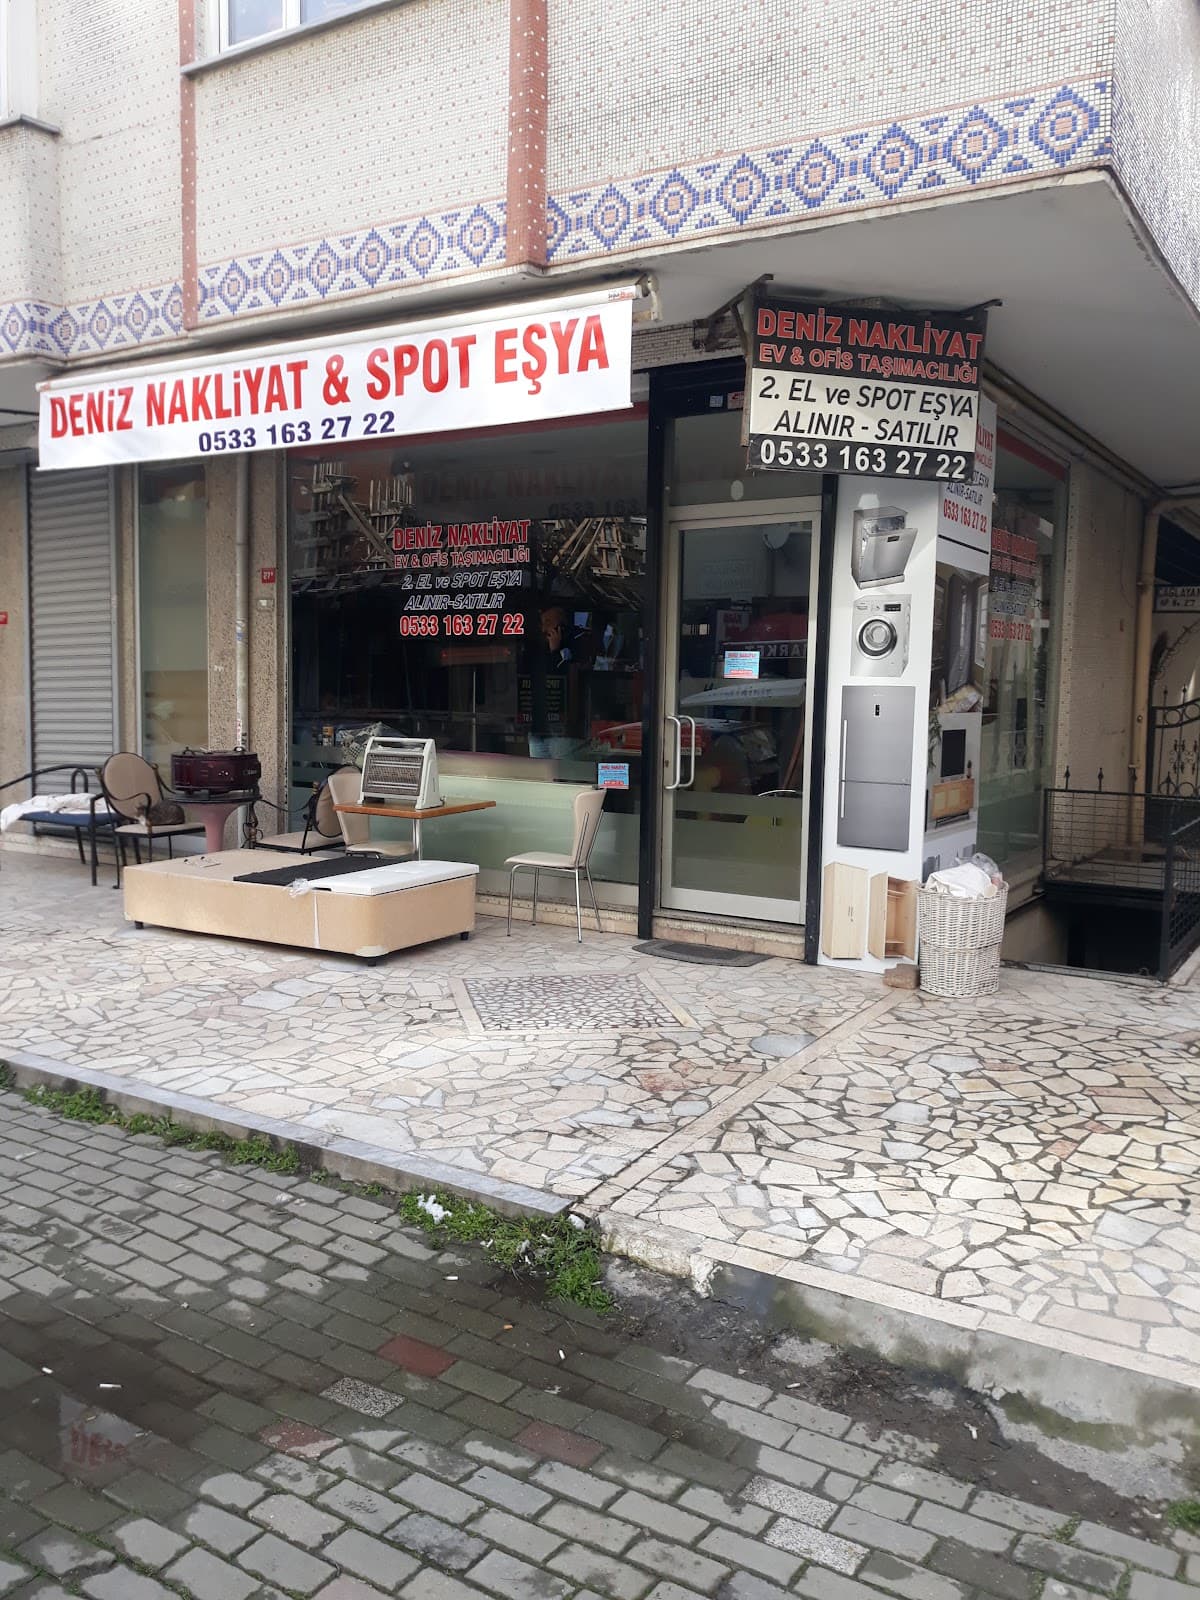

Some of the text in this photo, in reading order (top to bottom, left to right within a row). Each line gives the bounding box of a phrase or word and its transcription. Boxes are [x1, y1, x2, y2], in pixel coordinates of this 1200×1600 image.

[757, 307, 983, 360] DENİZ NAKLİYAT
[323, 354, 351, 405] &
[366, 334, 476, 401] SPOT
[494, 314, 609, 395] EŞYA
[759, 343, 978, 384] EV & OFİS TAŞIMACILIĞI
[759, 375, 974, 420] 2. EL ve SPOT EŞYA
[198, 411, 395, 452] 0533 163 27 22
[774, 410, 855, 437] ALINIR
[875, 418, 959, 447] SATILIR
[760, 439, 967, 479] 0533 163 27 22
[393, 516, 531, 550] DENİZ NAKLİYAT
[943, 499, 988, 533] 0533 163 27 22
[394, 545, 530, 569] EV & OFİS TAŞIMACILIĞI
[401, 570, 522, 590] 2. EL ve SPOT EŞYA
[400, 613, 524, 636] 0533 163 27 22
